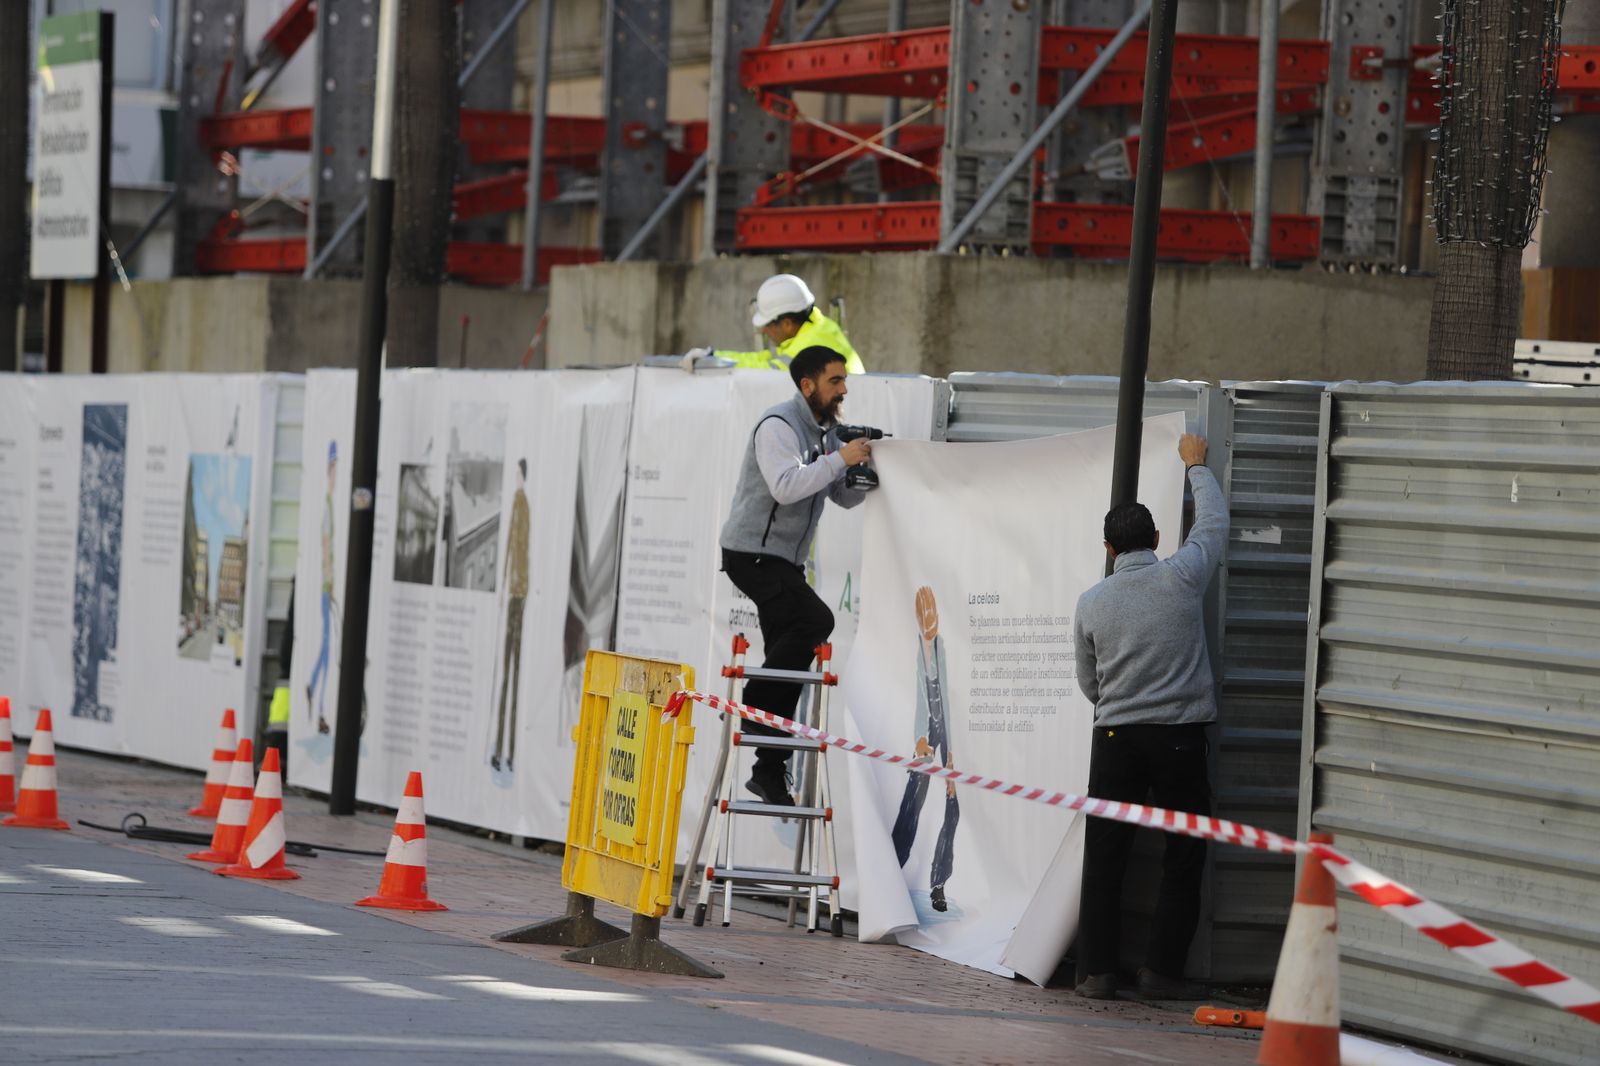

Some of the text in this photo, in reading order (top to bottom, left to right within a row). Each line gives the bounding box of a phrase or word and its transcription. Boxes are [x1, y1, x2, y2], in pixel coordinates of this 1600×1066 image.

[968, 591, 1000, 605] La celosía
[969, 616, 977, 627] Se
[978, 615, 1001, 630] plantea
[1001, 618, 1011, 627] un
[1055, 616, 1071, 626] como
[971, 633, 997, 645] elemento
[998, 632, 1032, 645] articulador
[997, 650, 1041, 664] contemporáneo
[969, 687, 1002, 697] estructura
[616, 706, 638, 740] CALLE
[608, 746, 636, 784] CORTADA
[603, 788, 636, 828] POR OBRAS
